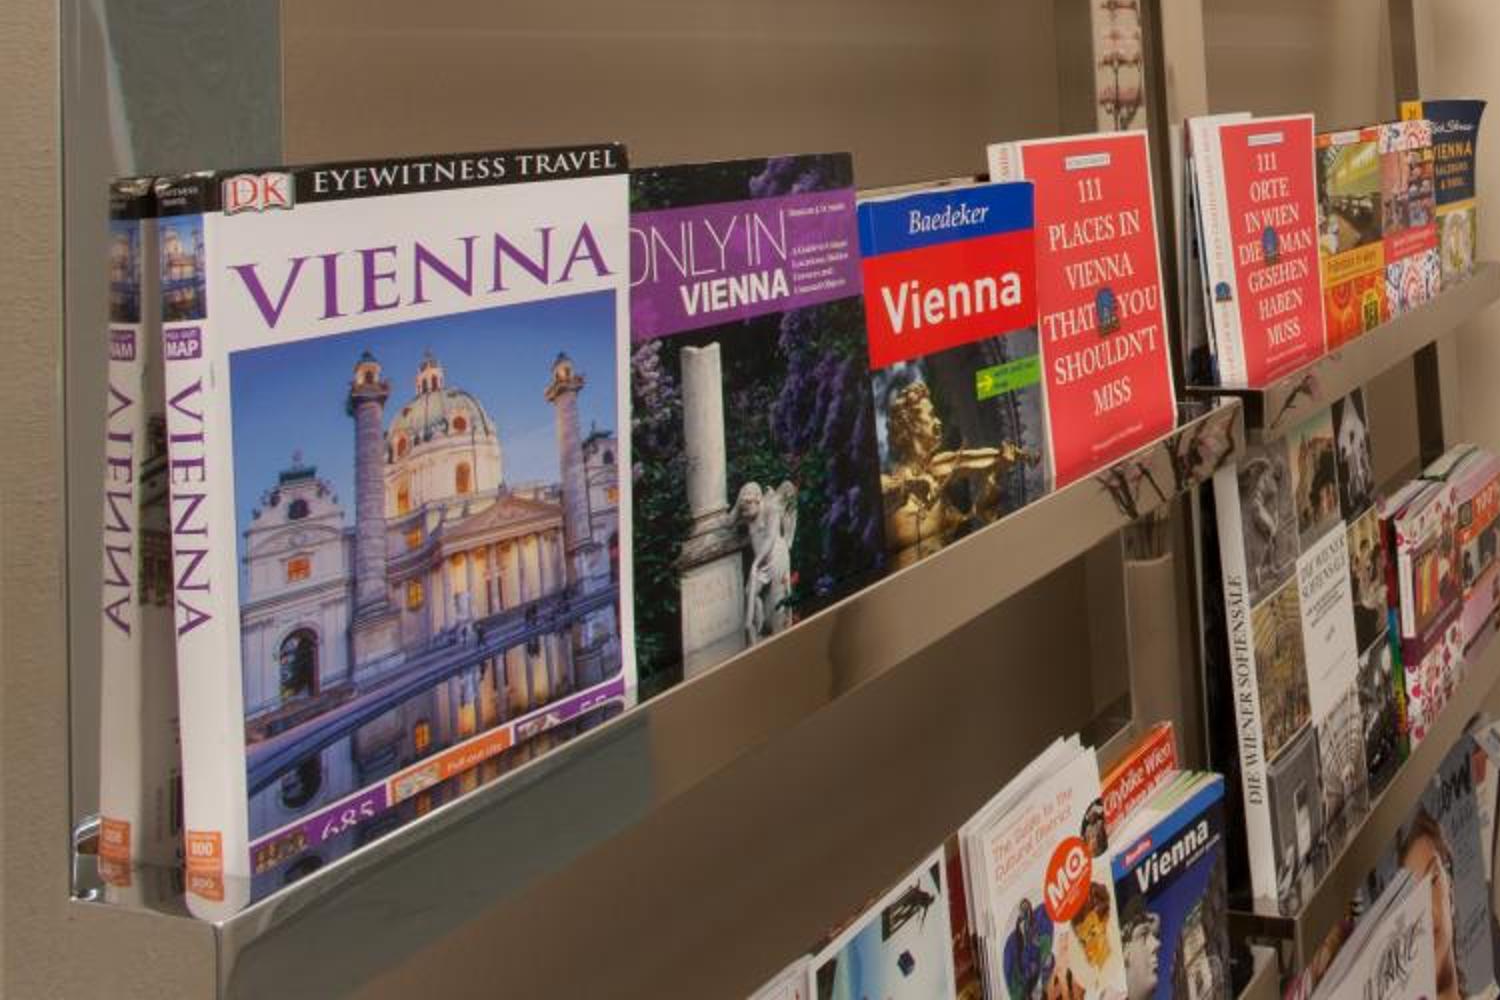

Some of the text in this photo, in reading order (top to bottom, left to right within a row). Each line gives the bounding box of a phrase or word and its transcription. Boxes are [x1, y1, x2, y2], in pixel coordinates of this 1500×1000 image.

[313, 148, 616, 194] EYEWITNESS TRAVEL
[1250, 177, 1289, 200] ORTE
[229, 177, 287, 209] DK
[909, 203, 989, 235] Baedeker
[1048, 210, 1140, 251] PLACES IN
[1244, 203, 1300, 234] IN WIEN
[1238, 227, 1313, 267] DIE MAN
[226, 221, 616, 330] VIENNA
[1065, 251, 1134, 290] VIENNA
[1248, 263, 1309, 293] GESEHEN
[680, 268, 790, 316] VIENNA
[881, 270, 1022, 335] Vienna
[1258, 291, 1303, 320] HABEN
[1044, 285, 1158, 343] THAT YOU
[165, 340, 200, 358] MAP
[1267, 321, 1300, 347] MUSS
[1054, 326, 1158, 385] SHOULDN'T
[1092, 378, 1131, 416] MISS
[166, 376, 212, 637] VIENNA
[1239, 693, 1260, 768] WIENER
[1247, 768, 1263, 805] DIE
[1136, 820, 1209, 894] Vienna
